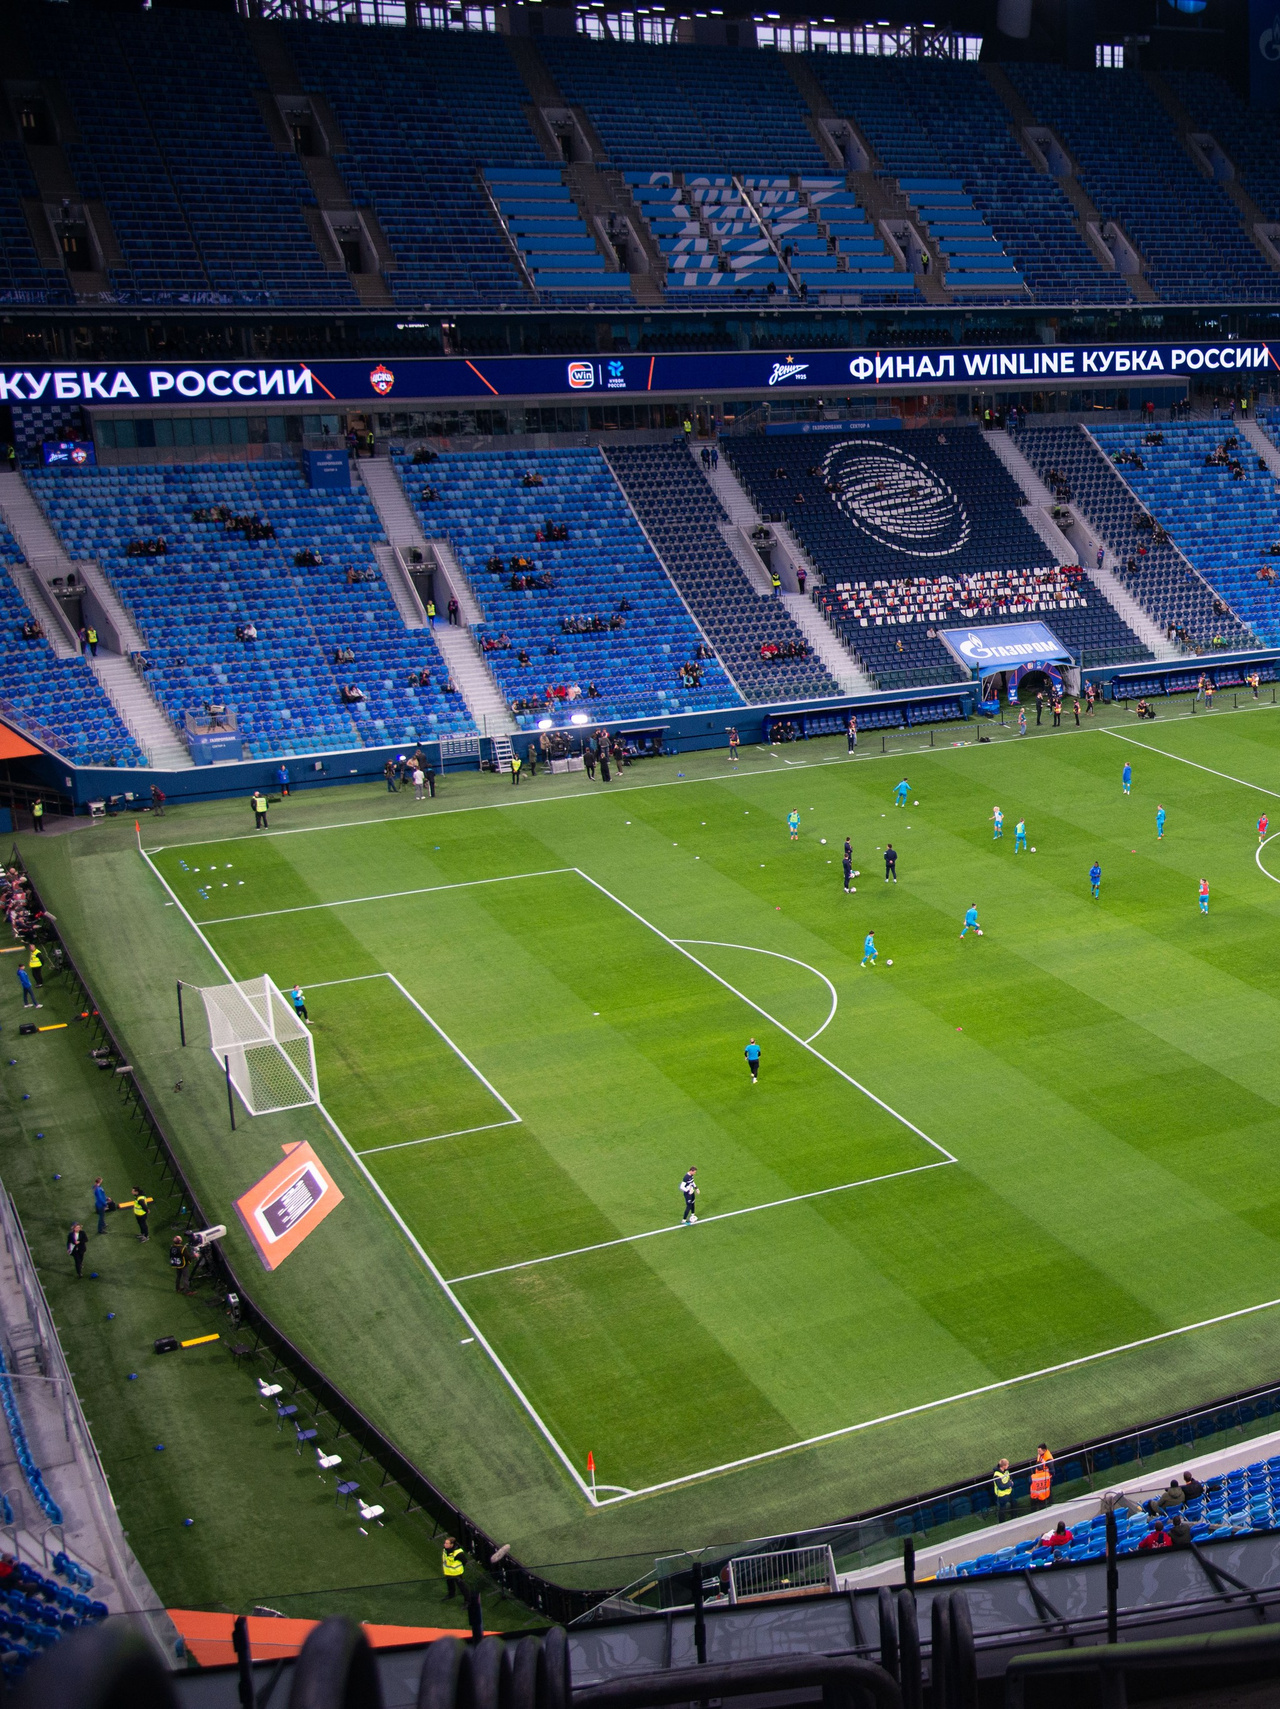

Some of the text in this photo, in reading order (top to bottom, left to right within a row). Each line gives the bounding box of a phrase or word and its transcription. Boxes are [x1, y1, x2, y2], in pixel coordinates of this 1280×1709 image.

[769, 363, 809, 385] Зенит
[849, 347, 1269, 380] ФИНАЛ WINLINE КУБКА РОССИИ
[0, 369, 313, 399] КУБКА РОССИИ
[574, 371, 592, 380] Win
[991, 640, 1059, 657] ГАЗПРОМ
